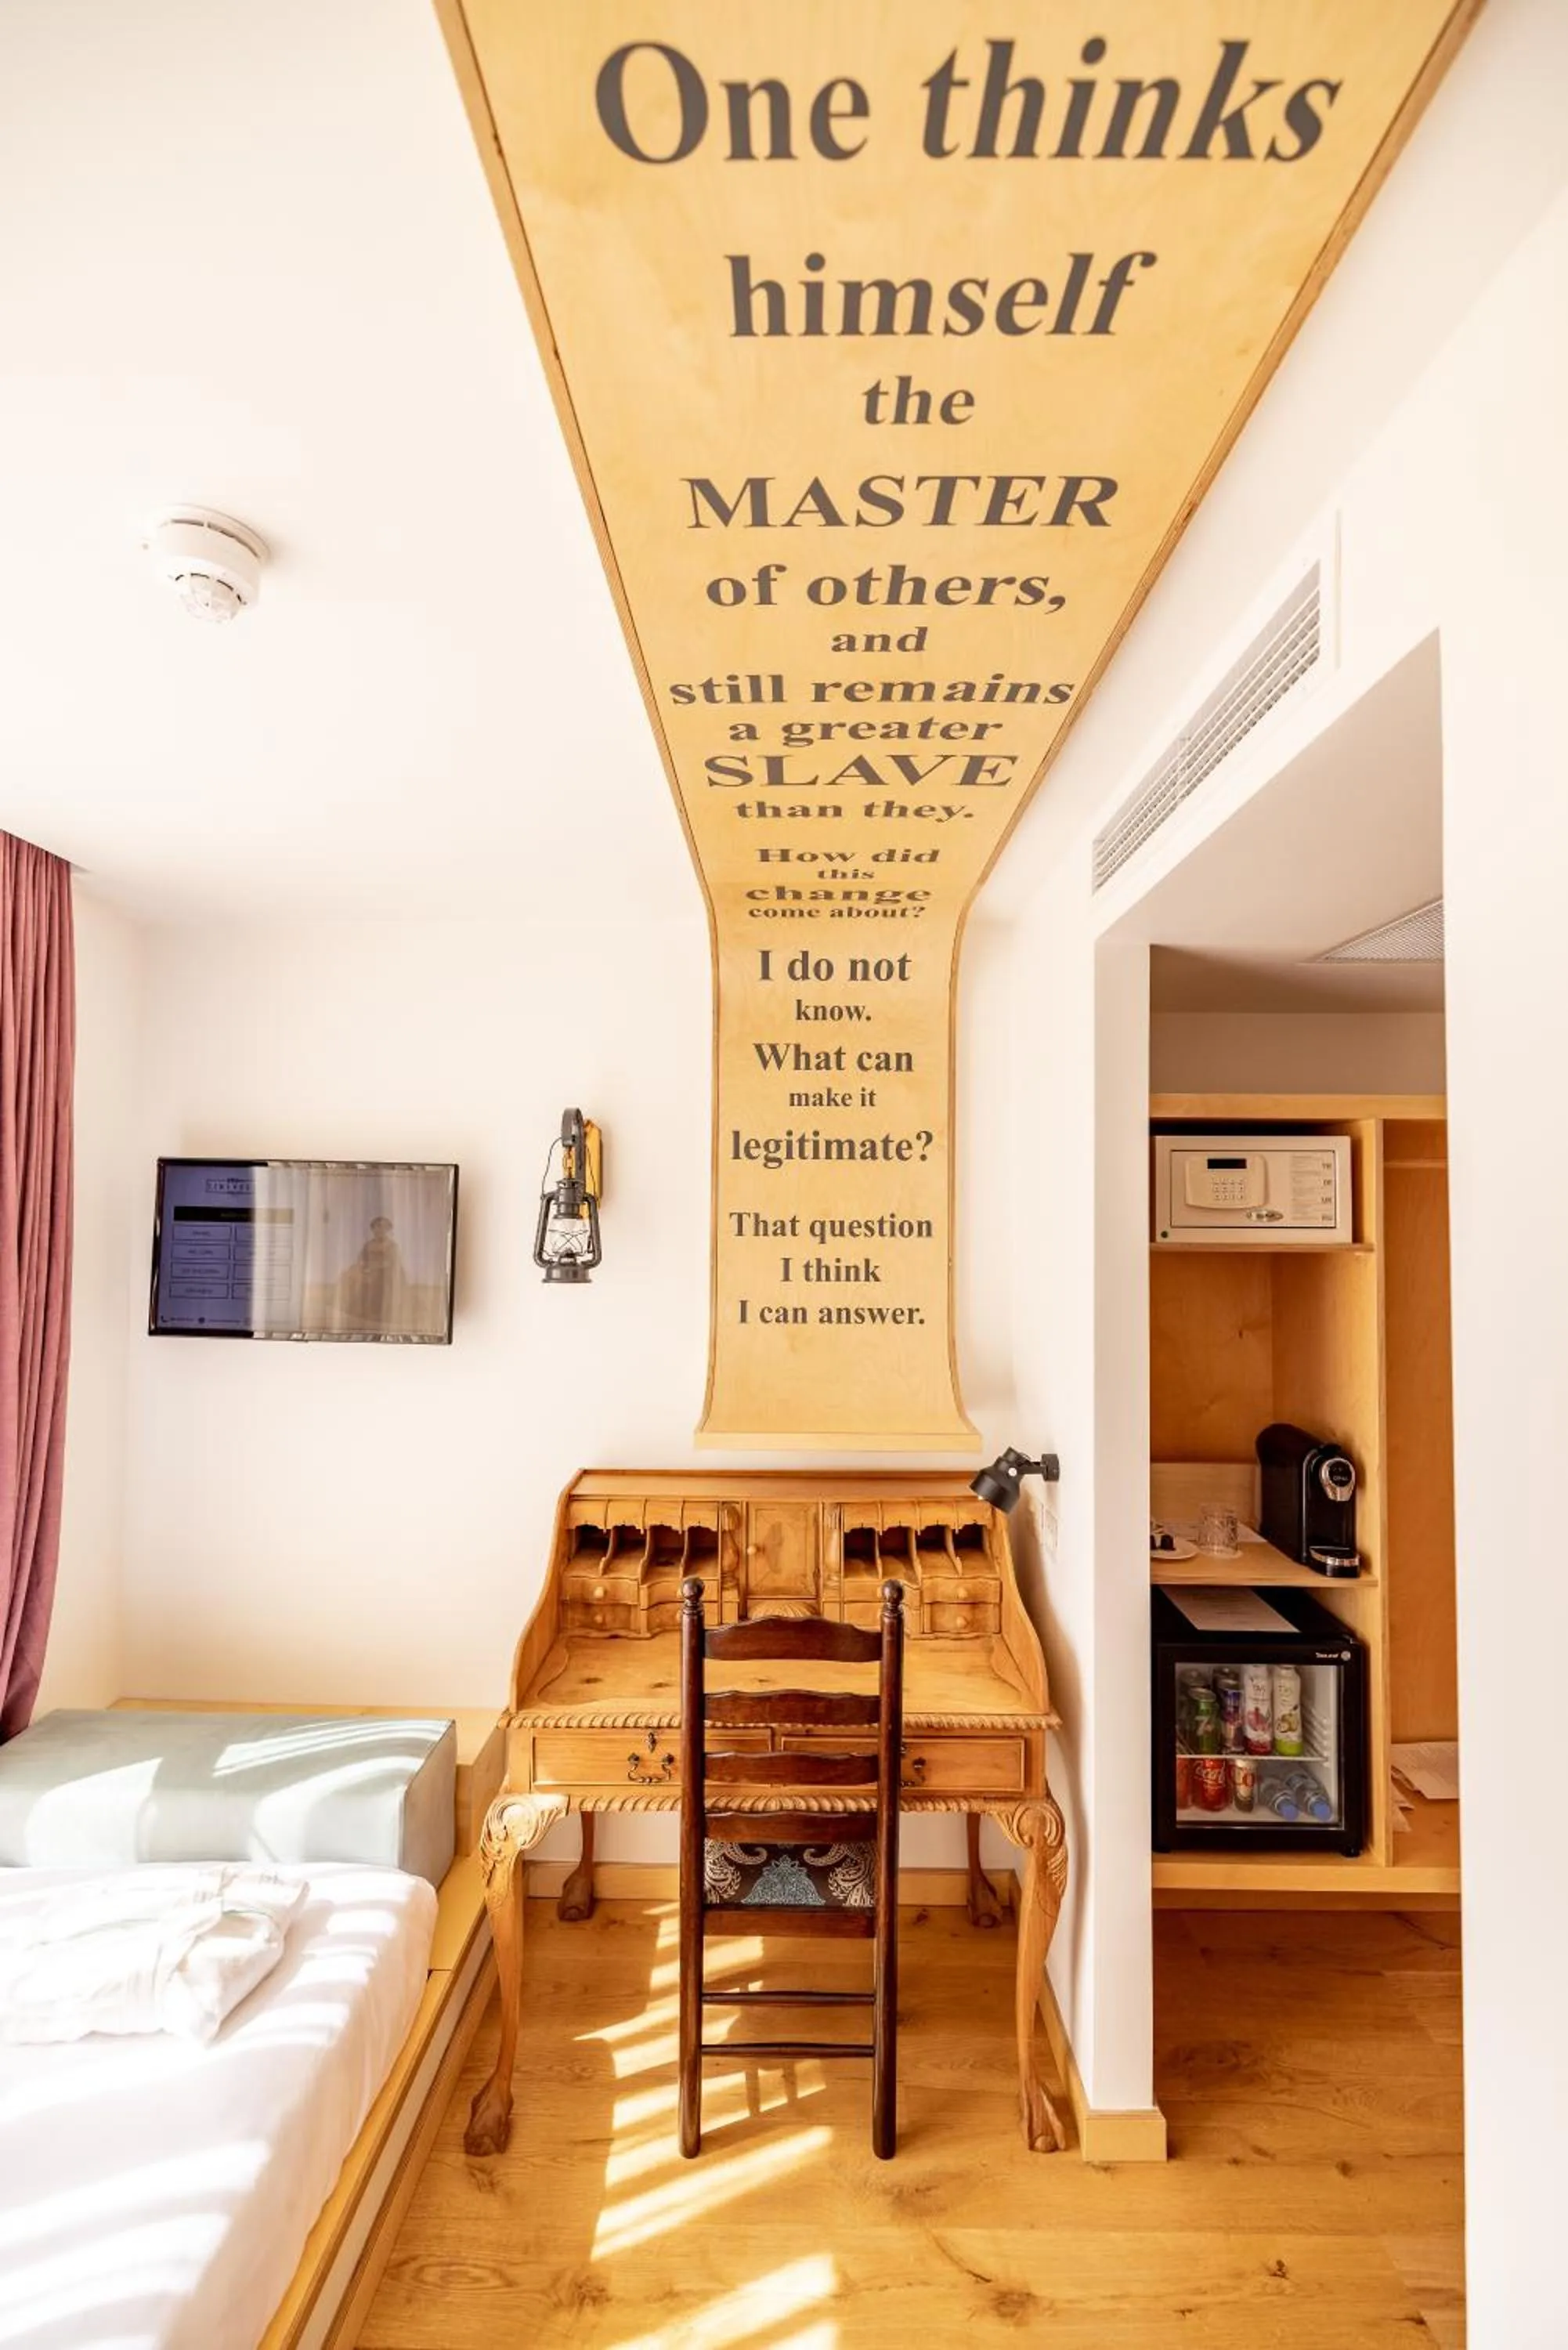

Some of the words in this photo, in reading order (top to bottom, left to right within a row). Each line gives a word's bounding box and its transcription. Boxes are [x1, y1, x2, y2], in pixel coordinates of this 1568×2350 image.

[596, 42, 869, 164] One
[923, 38, 1342, 163] thinks
[727, 251, 1158, 338] himself
[864, 375, 975, 425] the
[685, 475, 1118, 529] MASTER
[706, 564, 788, 607] of
[807, 565, 1067, 614] others,
[830, 626, 929, 653] and
[670, 674, 786, 705] still
[811, 673, 1076, 705] remains
[728, 723, 759, 741] a
[781, 718, 1004, 747] greater
[703, 754, 1018, 788] SLAVE
[735, 801, 844, 819] than
[863, 801, 974, 823] they.
[757, 848, 854, 863] How
[871, 848, 941, 863] did
[817, 869, 876, 880] this
[745, 885, 932, 906] change
[748, 908, 822, 919] come
[829, 906, 926, 919] about?
[760, 949, 772, 982] I
[787, 949, 835, 982] do
[849, 953, 912, 982] not
[795, 999, 873, 1022] know.
[753, 1042, 847, 1072] What
[855, 1051, 914, 1072] can
[788, 1086, 854, 1108] make
[859, 1086, 877, 1108] it
[731, 1130, 934, 1170] legitimate?
[728, 1211, 800, 1238] That
[809, 1212, 933, 1246] question
[780, 1257, 793, 1283] I
[803, 1257, 882, 1283] think
[739, 1299, 749, 1325] I
[758, 1306, 808, 1325] can
[818, 1306, 926, 1325] answer.
